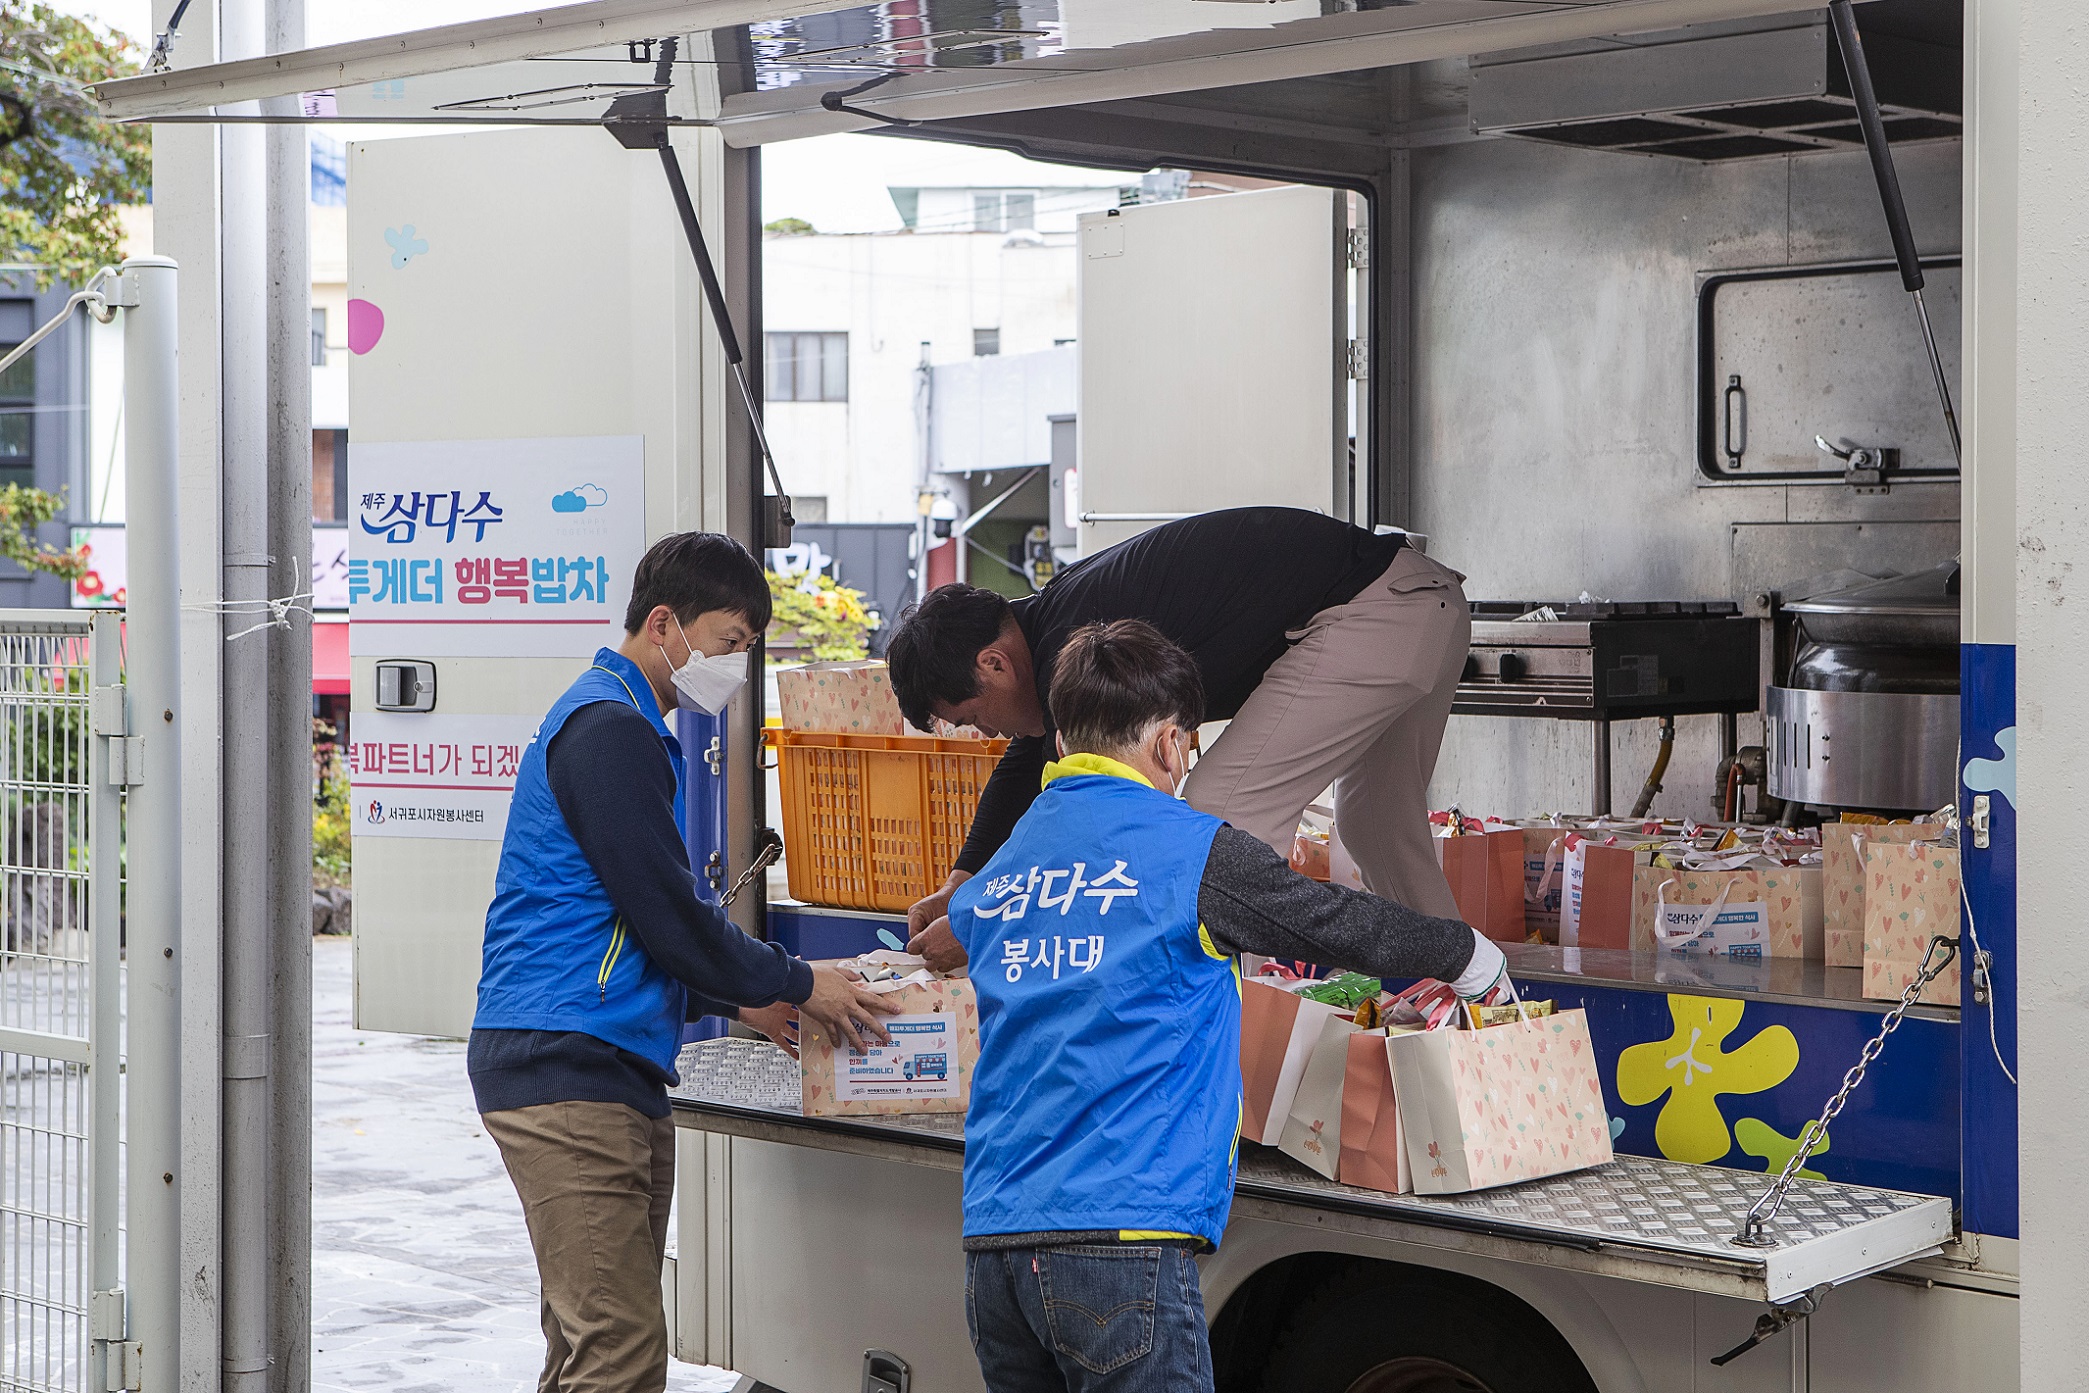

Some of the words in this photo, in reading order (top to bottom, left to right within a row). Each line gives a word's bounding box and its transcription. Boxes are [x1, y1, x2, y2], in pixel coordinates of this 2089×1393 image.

[360, 492, 386, 510] 제주
[360, 490, 503, 544] 삼다수
[454, 555, 610, 605] 행복밥차
[388, 806, 485, 823] 서귀포시자원봉사센터
[973, 859, 1139, 922] 삼다수
[982, 873, 1011, 897] 제주
[1000, 935, 1105, 983] 봉사대
[1431, 1165, 1448, 1178] LOVE
